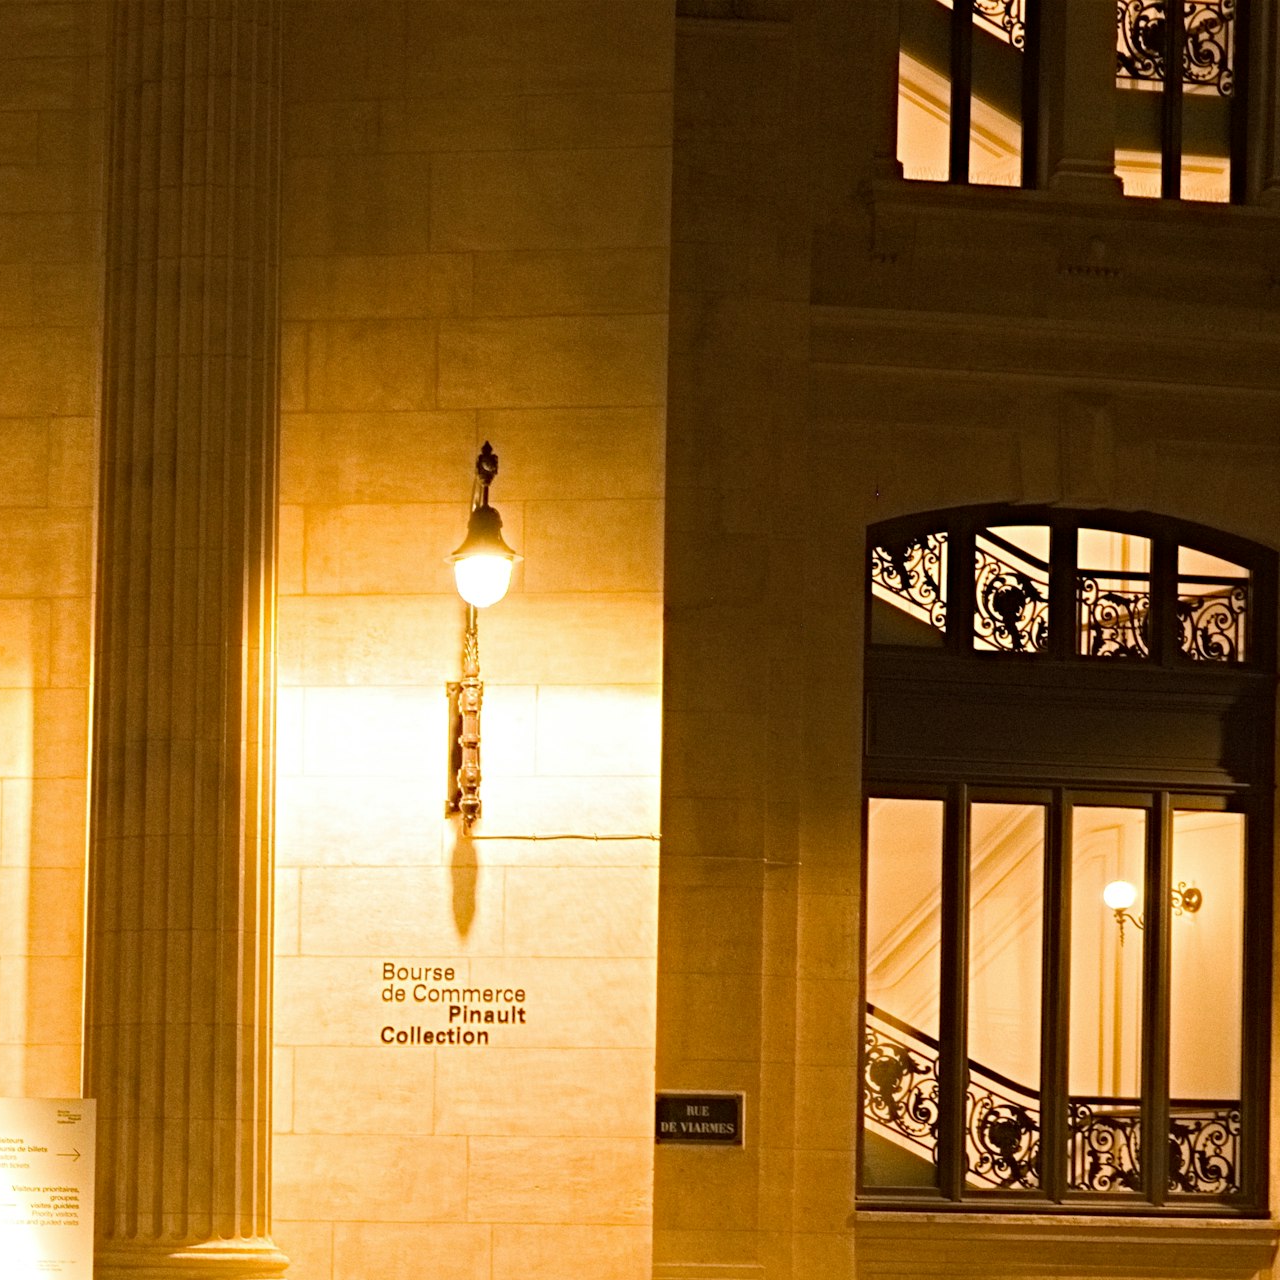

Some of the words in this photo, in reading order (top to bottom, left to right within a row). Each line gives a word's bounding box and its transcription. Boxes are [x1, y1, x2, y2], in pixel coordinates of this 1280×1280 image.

[382, 962, 456, 981] Bourse
[381, 984, 406, 1002] de
[413, 984, 526, 1003] Commerce
[449, 1005, 527, 1024] Pinault
[380, 1026, 489, 1045] Collection
[686, 1104, 710, 1117] RUE
[660, 1121, 677, 1133] DE
[680, 1121, 735, 1135] VIARMES
